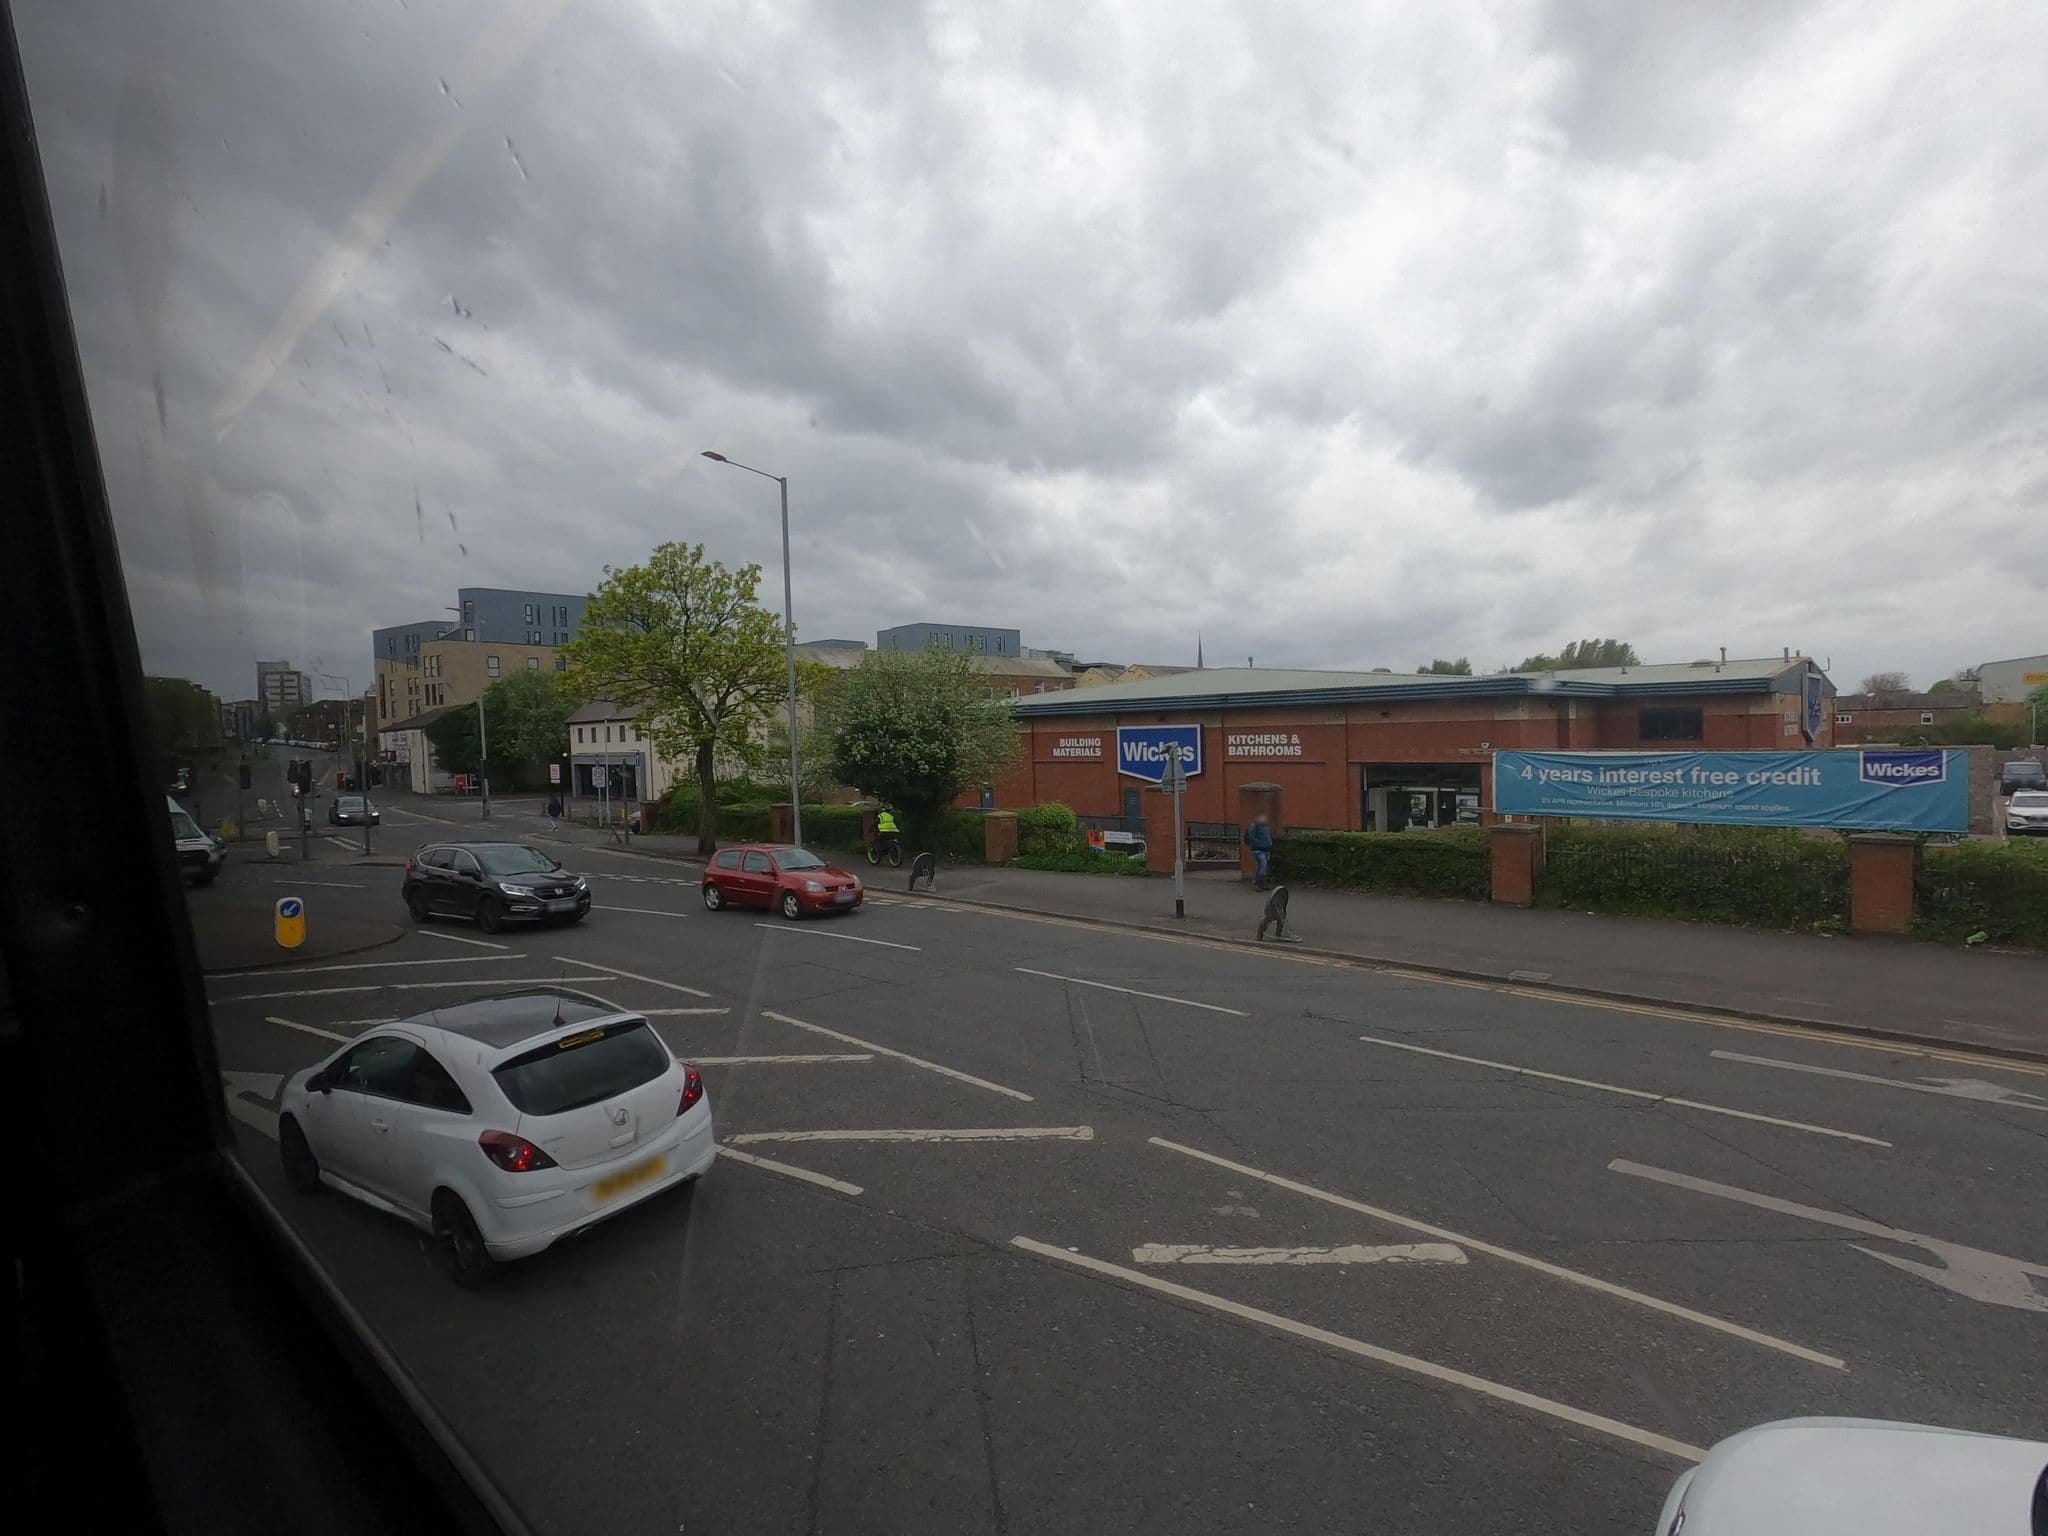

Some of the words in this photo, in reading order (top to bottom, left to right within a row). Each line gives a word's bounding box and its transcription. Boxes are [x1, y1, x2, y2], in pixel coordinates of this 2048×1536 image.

[1059, 737, 1101, 747] BUILDING
[1228, 734, 1287, 745] KITCHENS
[1291, 734, 1301, 744] &
[1053, 747, 1102, 757] MATERIALS
[1228, 746, 1302, 756] BATHROOMS
[1521, 765, 1533, 780] 4
[1538, 768, 1593, 785] years
[1599, 766, 1684, 784] interest
[1690, 766, 1739, 785] free
[1746, 766, 1821, 786] credit
[1865, 763, 1940, 777] Wickes
[1587, 785, 1626, 796] Wickes
[1629, 786, 1679, 798] Bespoke
[1682, 787, 1735, 799] kitchens
